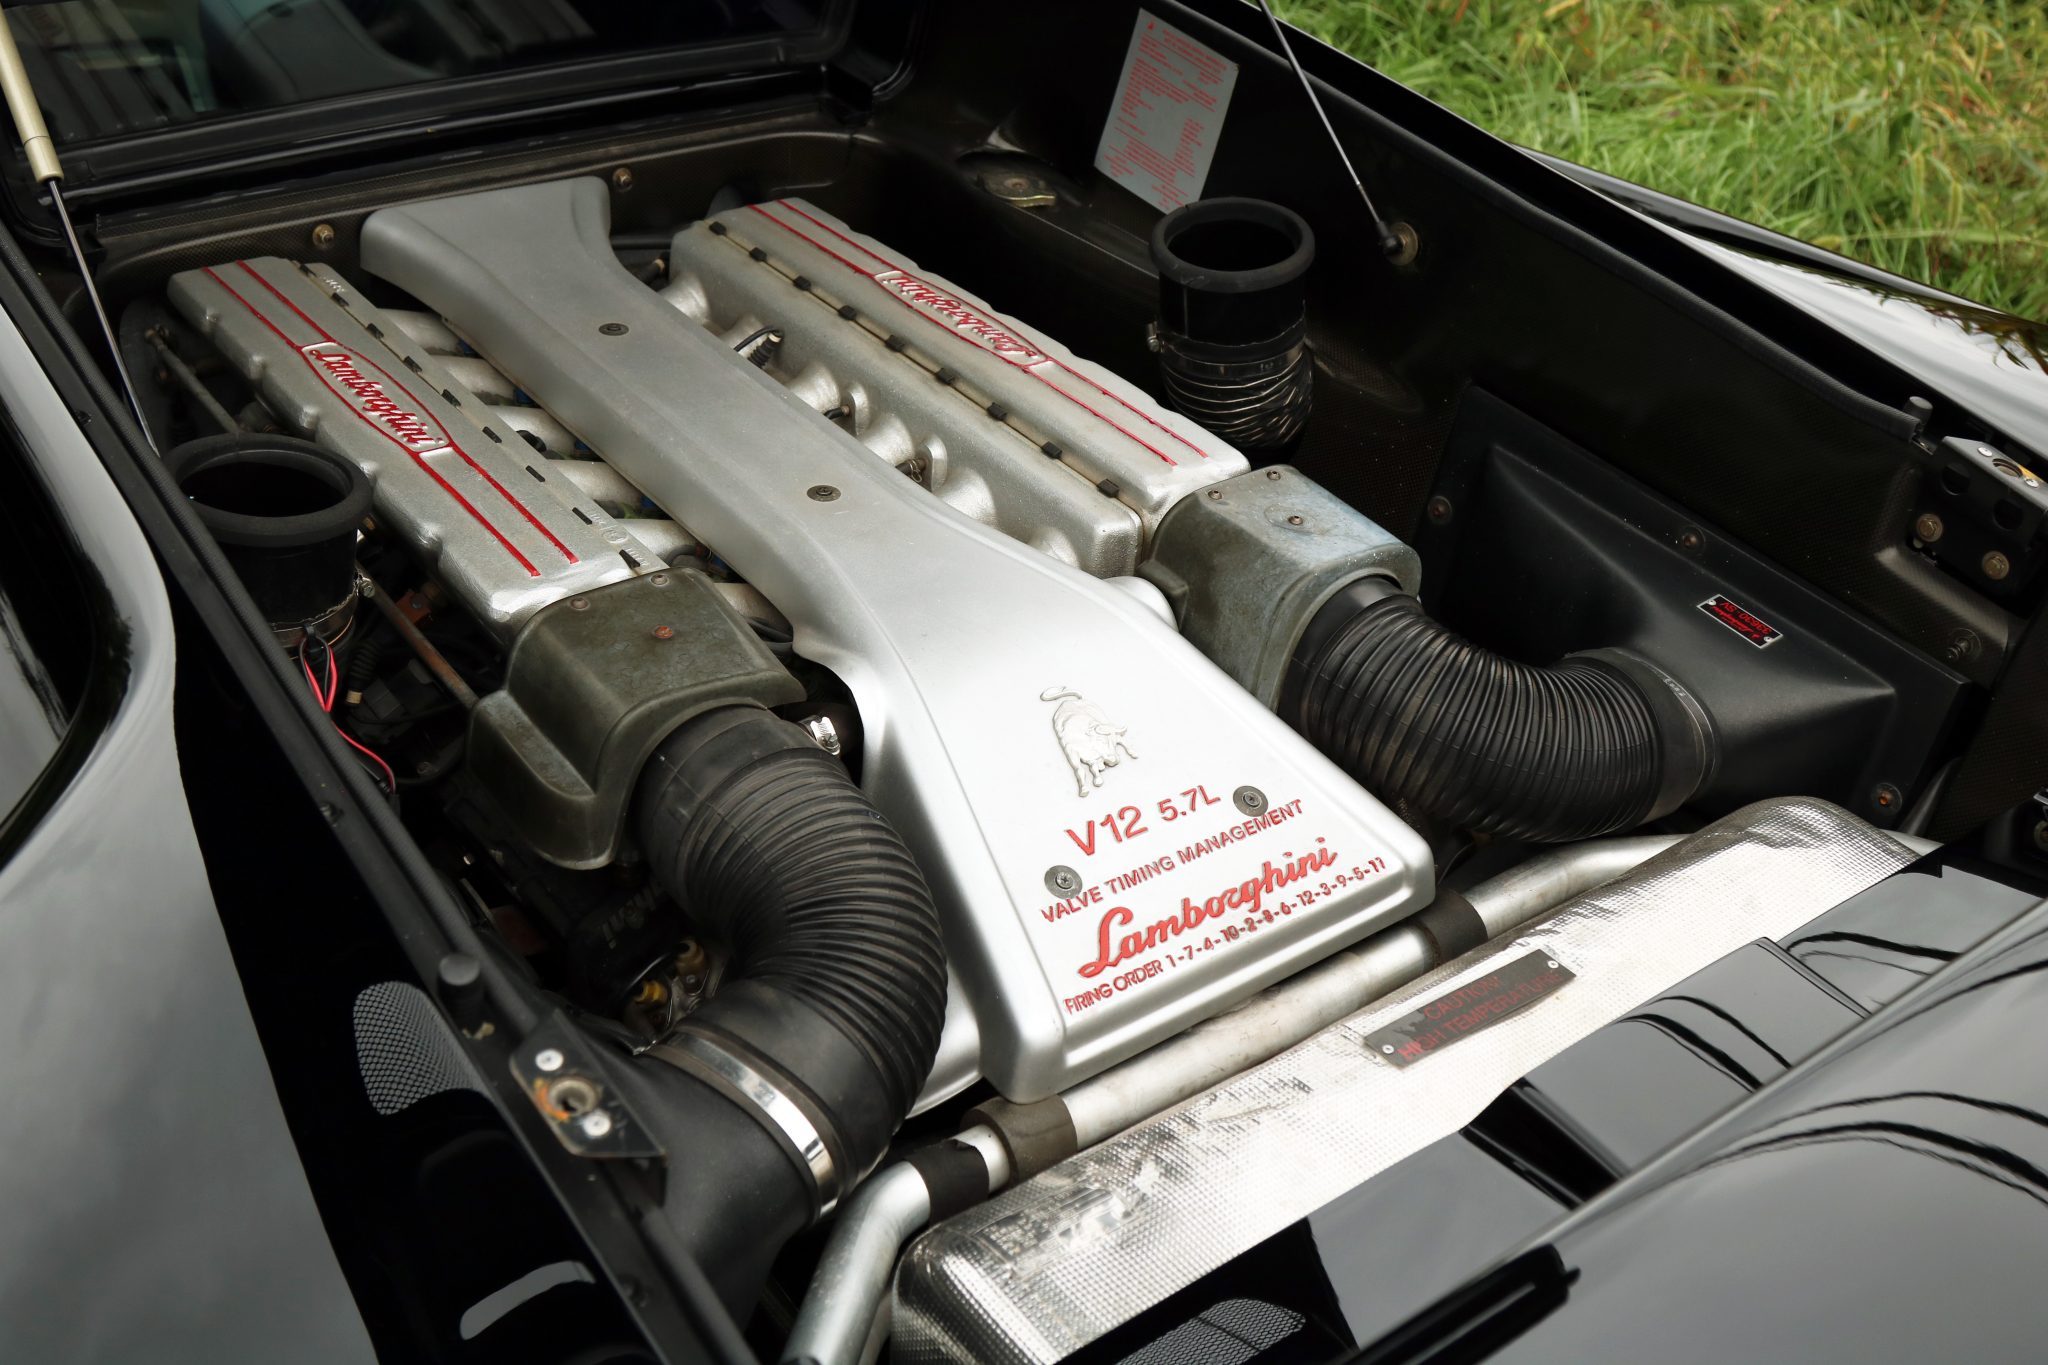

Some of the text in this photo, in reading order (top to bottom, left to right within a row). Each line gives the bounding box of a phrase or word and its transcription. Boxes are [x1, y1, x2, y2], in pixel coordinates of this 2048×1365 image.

[883, 276, 1038, 359] Lamborghini
[309, 350, 444, 447] Lamborghini
[1041, 799, 1304, 923] VALVE TIMING MANAGEMENT
[1065, 785, 1221, 856] V12 5.7L
[1077, 837, 1338, 979] Lamborghini
[1064, 982, 1113, 1014] FIRING
[1113, 959, 1164, 992] ORDER
[1396, 1031, 1448, 1061] HIGH
